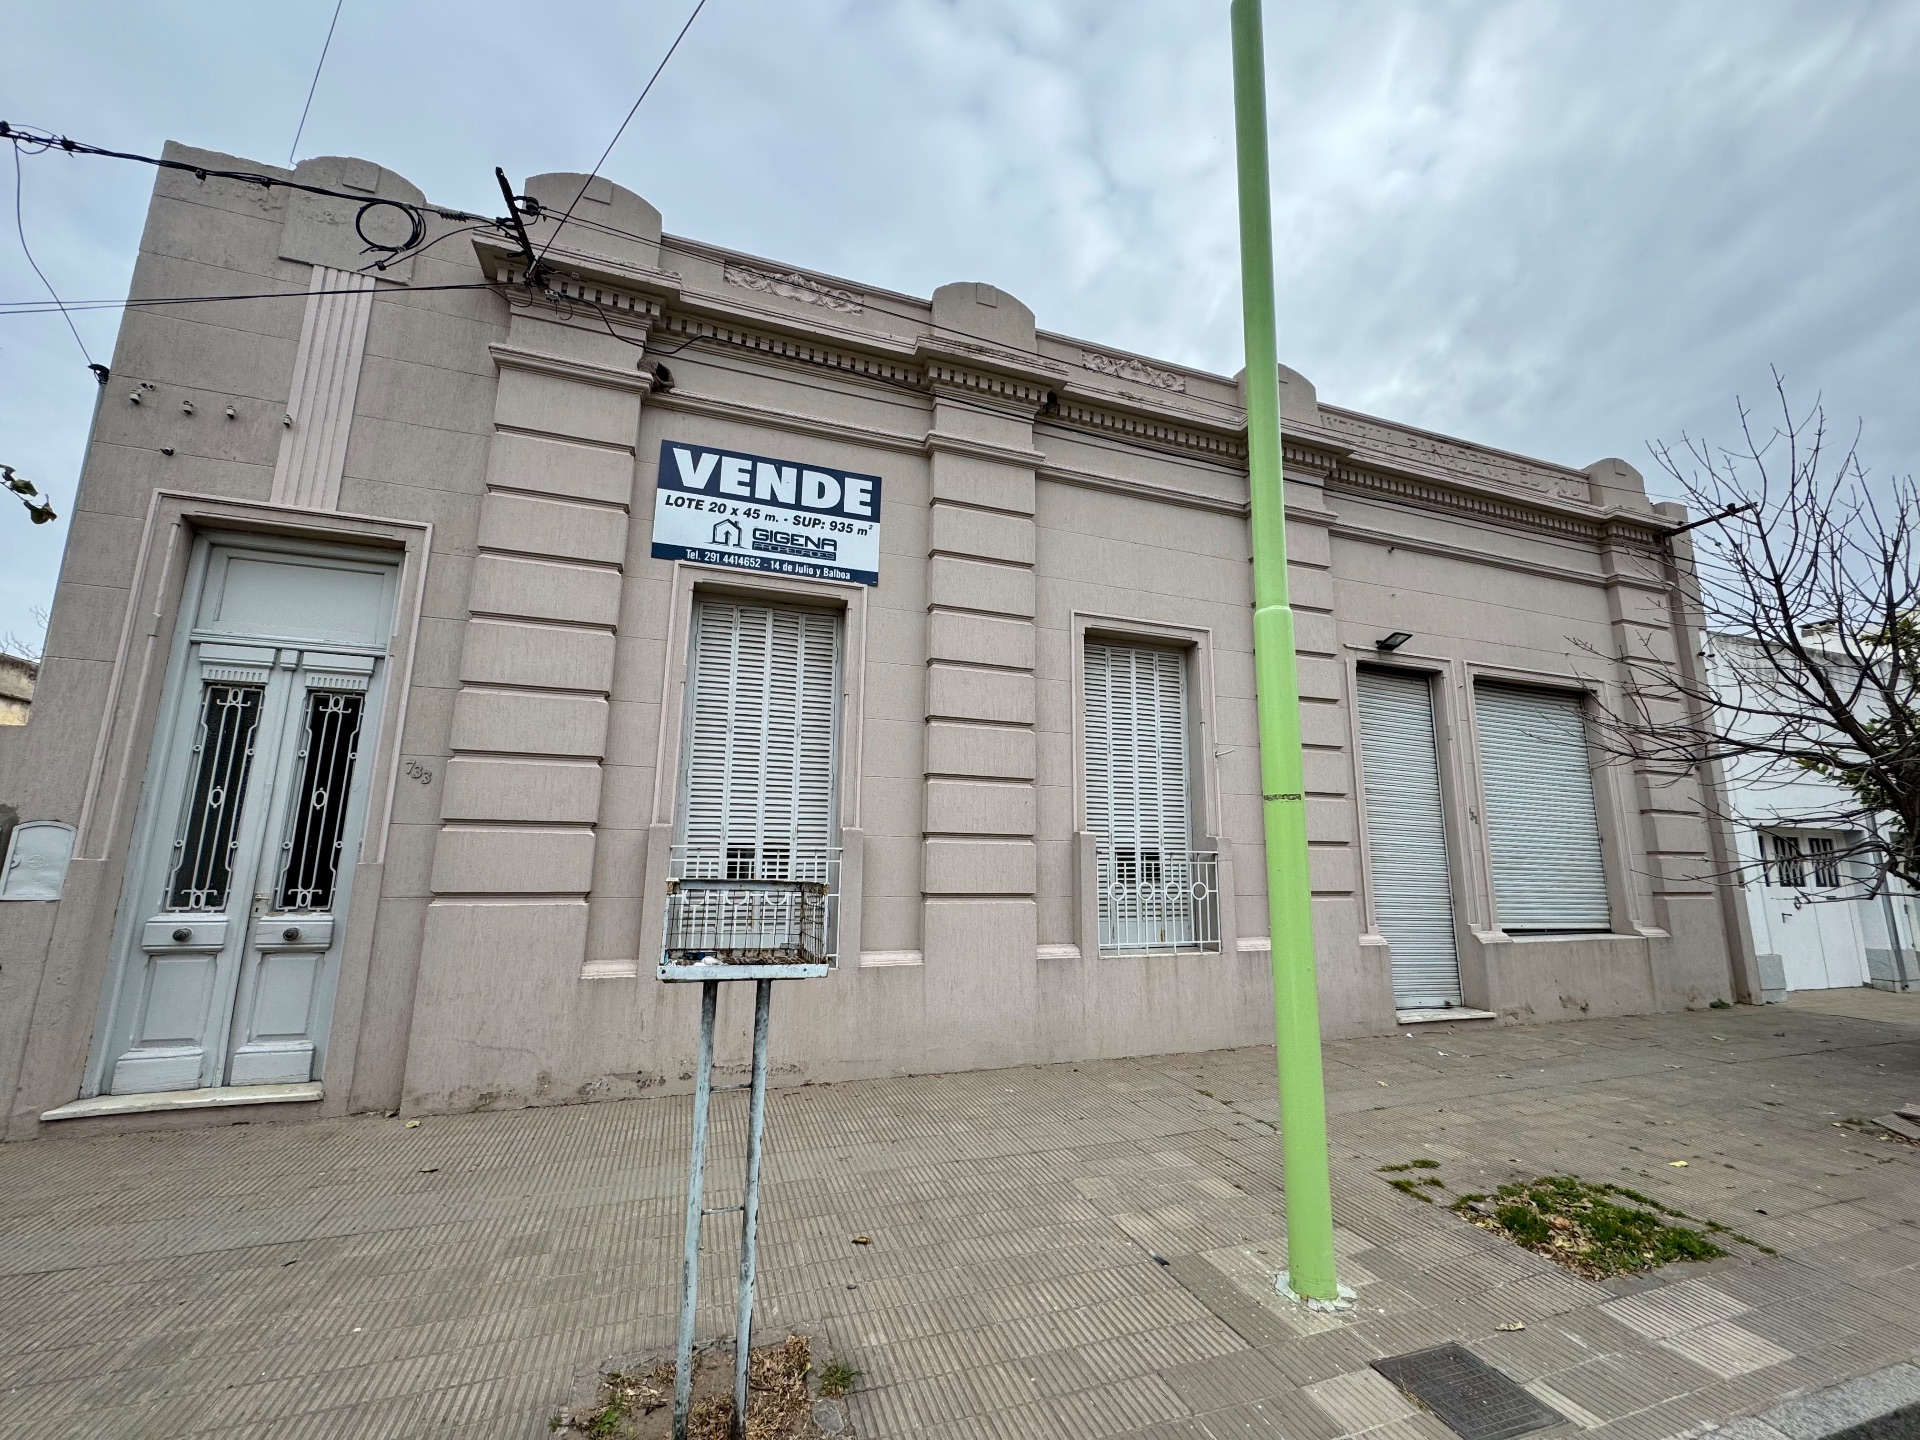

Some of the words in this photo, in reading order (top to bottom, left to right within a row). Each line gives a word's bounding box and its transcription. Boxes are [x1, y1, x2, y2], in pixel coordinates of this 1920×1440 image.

[672, 447, 872, 516] VENDE
[665, 494, 705, 511] LOTE
[708, 502, 727, 514] 20
[730, 507, 739, 516] x
[743, 508, 761, 519] 45
[764, 513, 779, 523] m.
[792, 515, 826, 530] SUP:
[829, 520, 854, 534] 935
[752, 527, 838, 552] GIGENA
[686, 548, 701, 560] Tel.
[704, 551, 720, 563] 291
[723, 553, 761, 568] 4414652
[770, 560, 780, 571] 14
[782, 562, 793, 572] de
[795, 563, 814, 575] Julio
[815, 568, 821, 578] y
[823, 567, 851, 580] Balboa
[405, 760, 432, 785] 733
